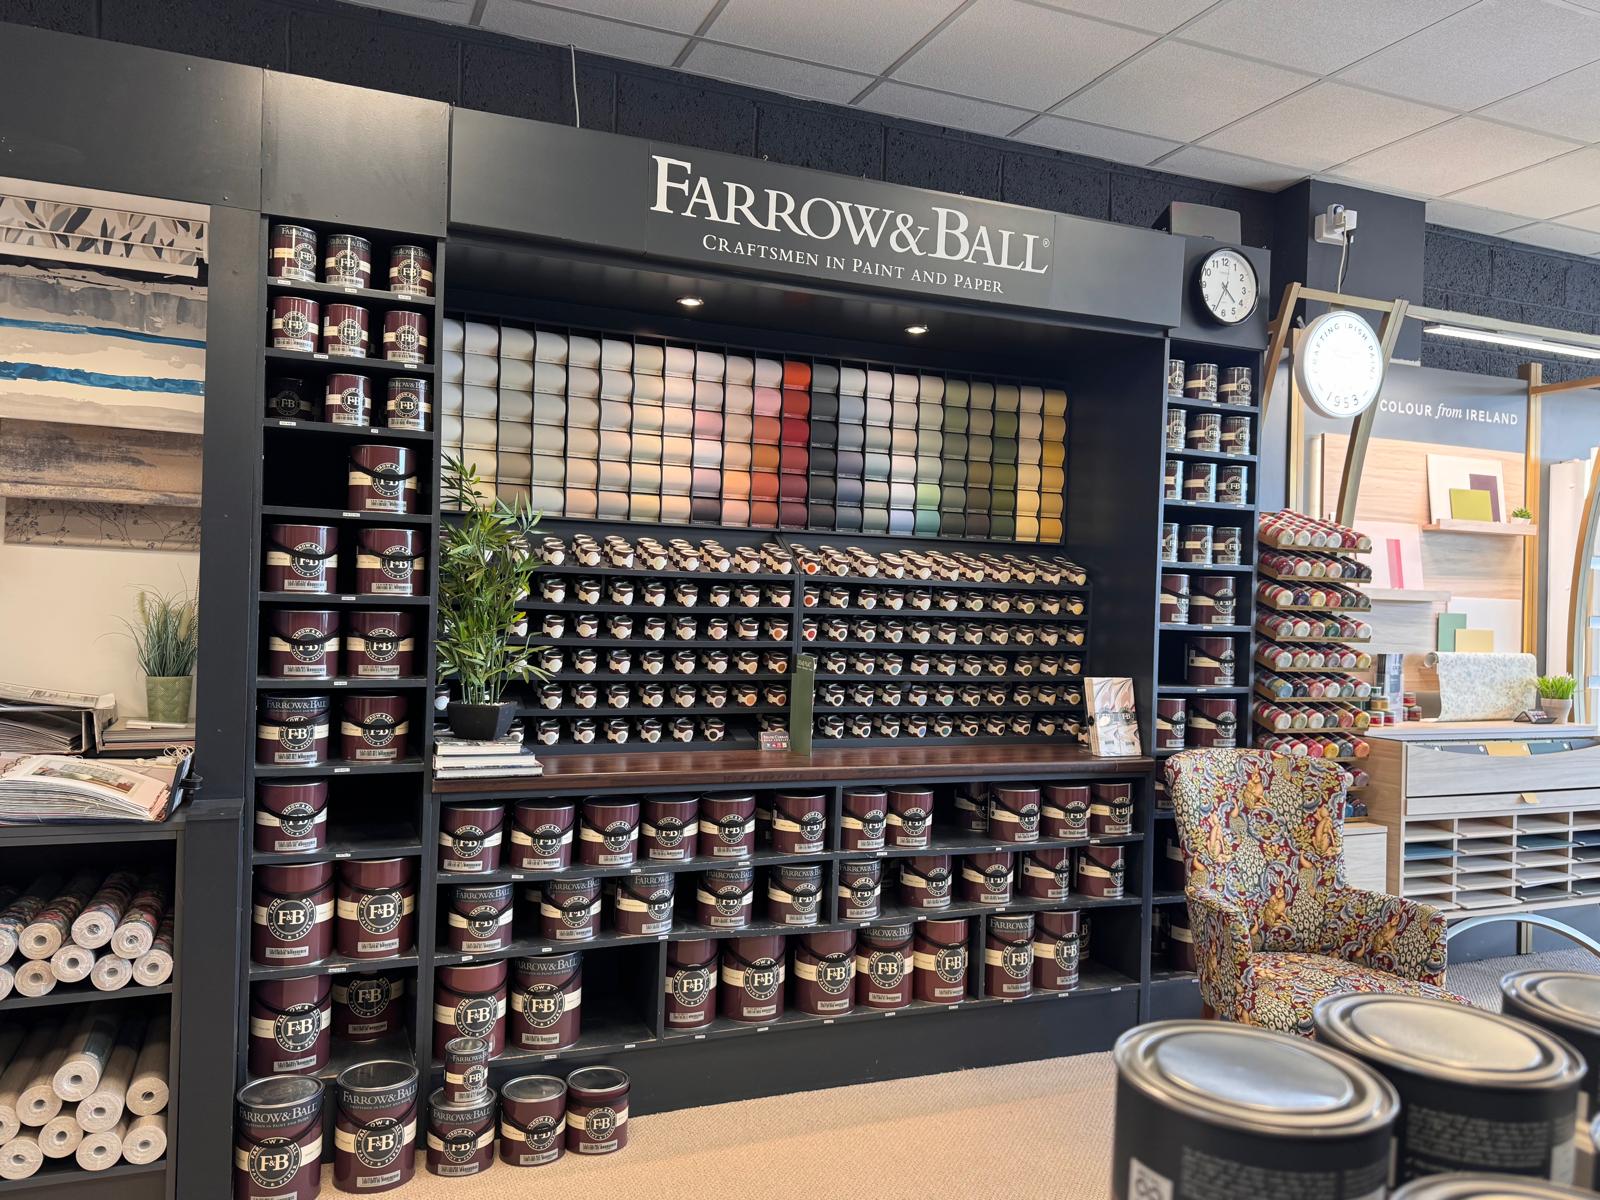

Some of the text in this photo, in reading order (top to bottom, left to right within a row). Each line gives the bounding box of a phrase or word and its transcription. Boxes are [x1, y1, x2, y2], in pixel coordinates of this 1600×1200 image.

[702, 234, 1004, 294] CRAFTSMEN IN PAINT AND PAPER
[1212, 260, 1219, 268] 11
[1221, 258, 1229, 267] 12
[1233, 263, 1237, 272] 1
[1204, 268, 1211, 277] 10
[1239, 273, 1244, 282] 2
[1202, 280, 1207, 289] 9
[1241, 286, 1247, 295] 3
[1204, 294, 1209, 302] 8
[1238, 299, 1243, 307] 4
[1221, 309, 1226, 317] 6
[1231, 307, 1236, 315] 5
[1326, 391, 1359, 409] 1953
[1379, 399, 1518, 425] COLOUR from IRELAND
[277, 909, 305, 926] F&B
[369, 902, 396, 919] F&B
[826, 968, 846, 982] F&B
[877, 962, 898, 975] F&B
[682, 978, 704, 993] F&B
[754, 972, 774, 986] F&B
[358, 985, 382, 1003] F&B
[531, 998, 556, 1013] F&B
[466, 1007, 490, 1024] F&B
[286, 1018, 313, 1036] F&B
[593, 1118, 610, 1130] F&B
[366, 1134, 395, 1152] F&B
[259, 1153, 290, 1172] F&B
